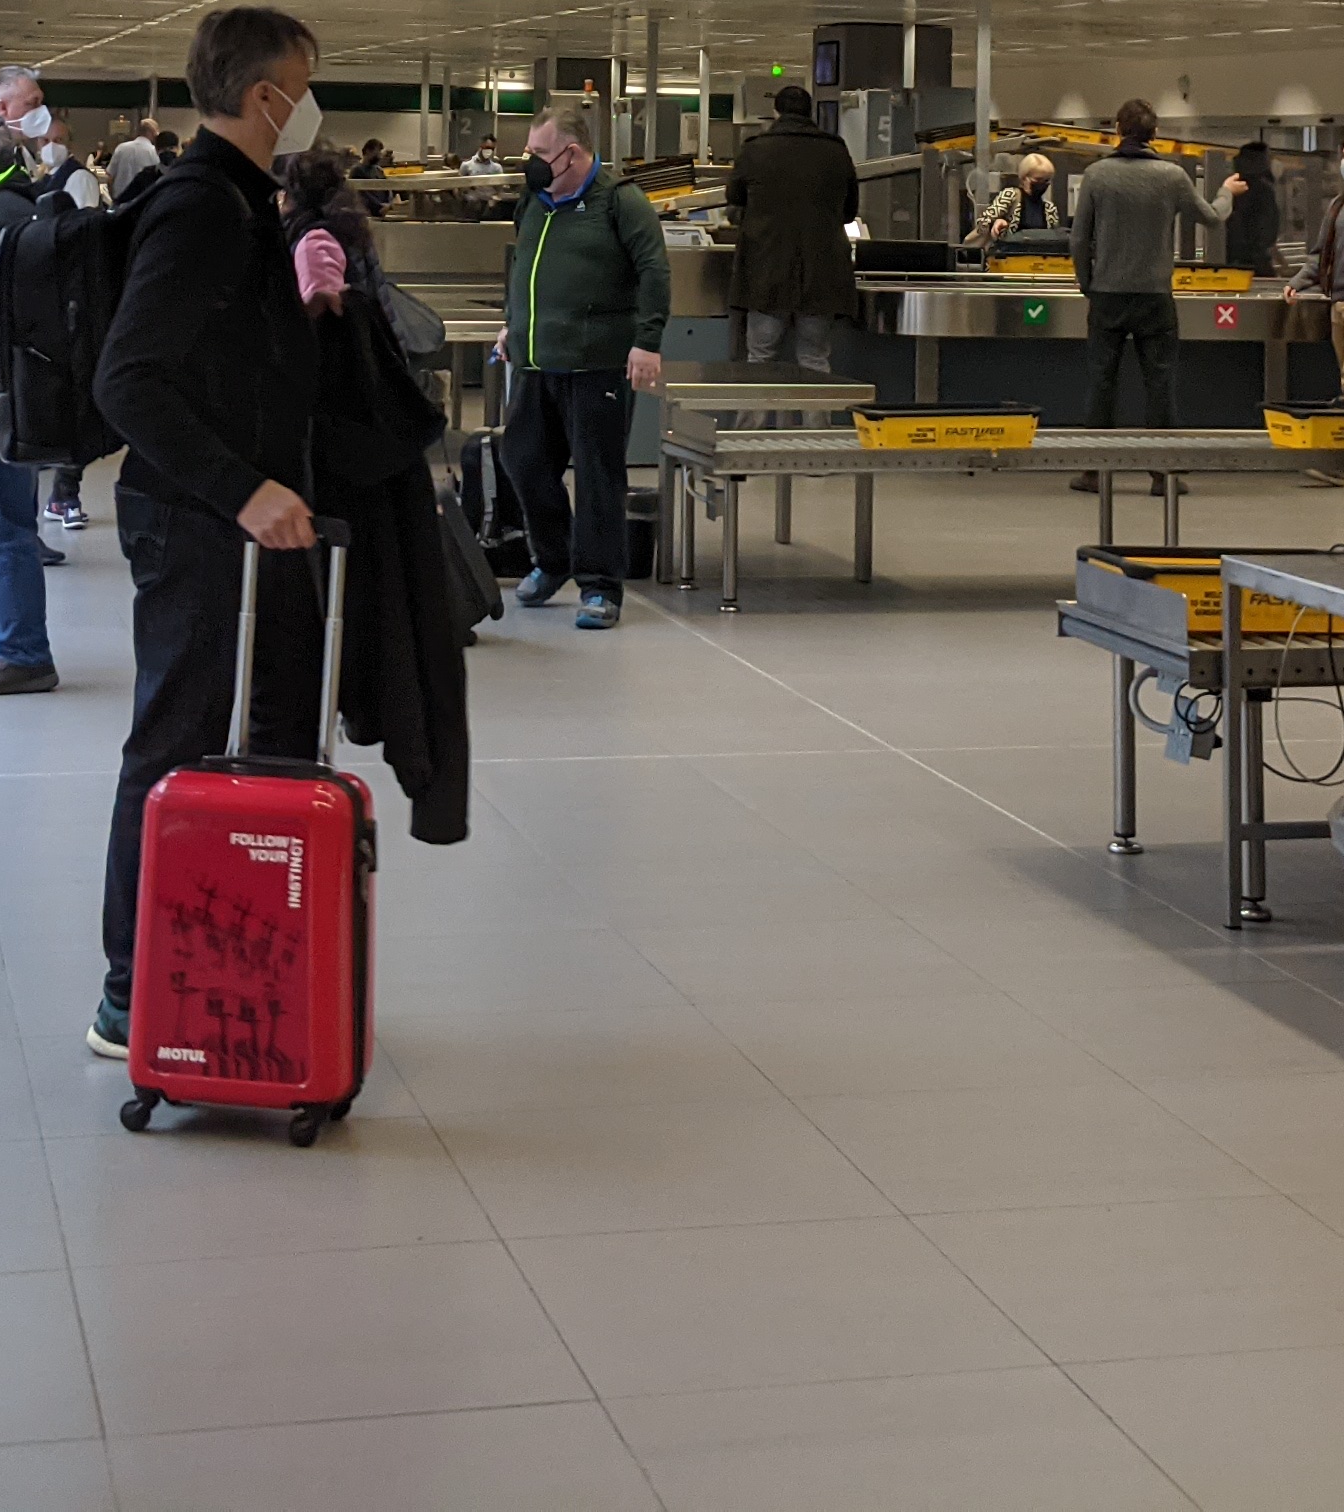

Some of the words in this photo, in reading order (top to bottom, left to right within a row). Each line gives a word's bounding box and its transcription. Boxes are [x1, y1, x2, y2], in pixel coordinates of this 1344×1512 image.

[460, 117, 472, 135] 2
[229, 832, 290, 848] FOLLOW
[248, 848, 288, 863] YOUR
[287, 836, 304, 908] INSTINCT
[157, 1045, 207, 1063] MOTUL
